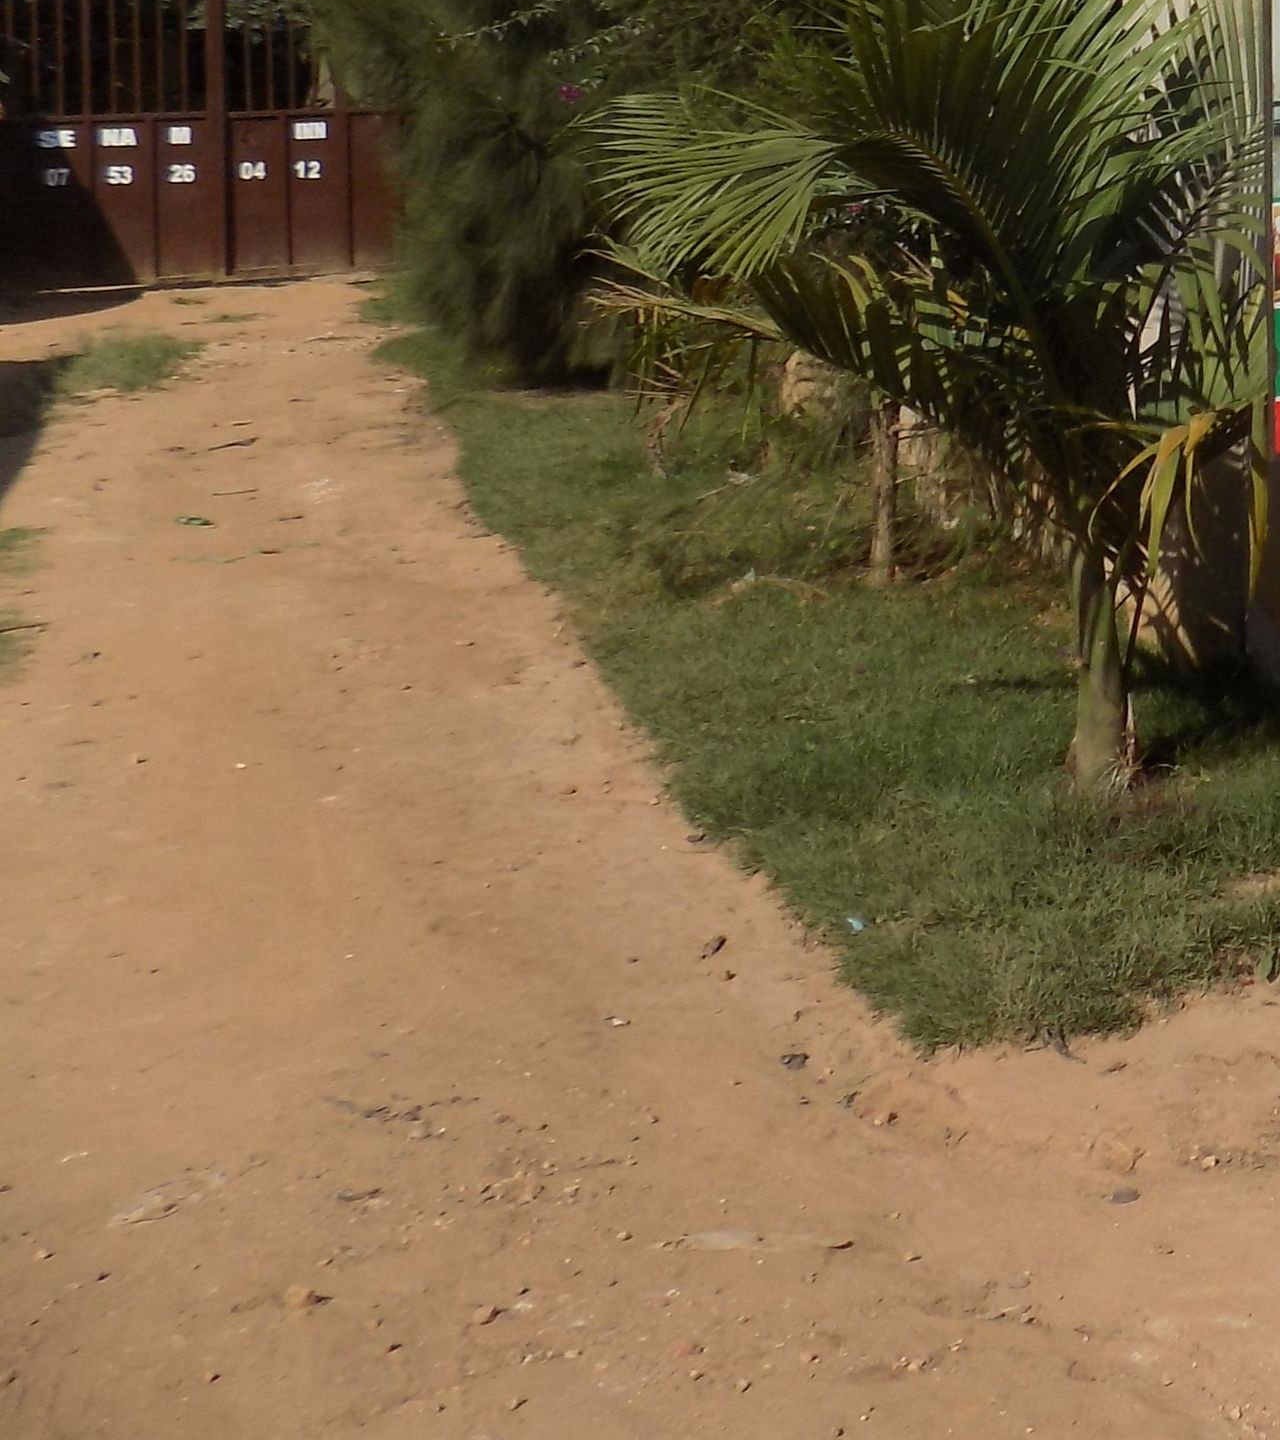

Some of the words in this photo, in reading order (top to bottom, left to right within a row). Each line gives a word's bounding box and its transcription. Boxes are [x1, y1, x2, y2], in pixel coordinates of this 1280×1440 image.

[107, 165, 134, 185] 53
[168, 163, 196, 183] 26
[239, 161, 267, 180] 04
[293, 160, 321, 179] 12
